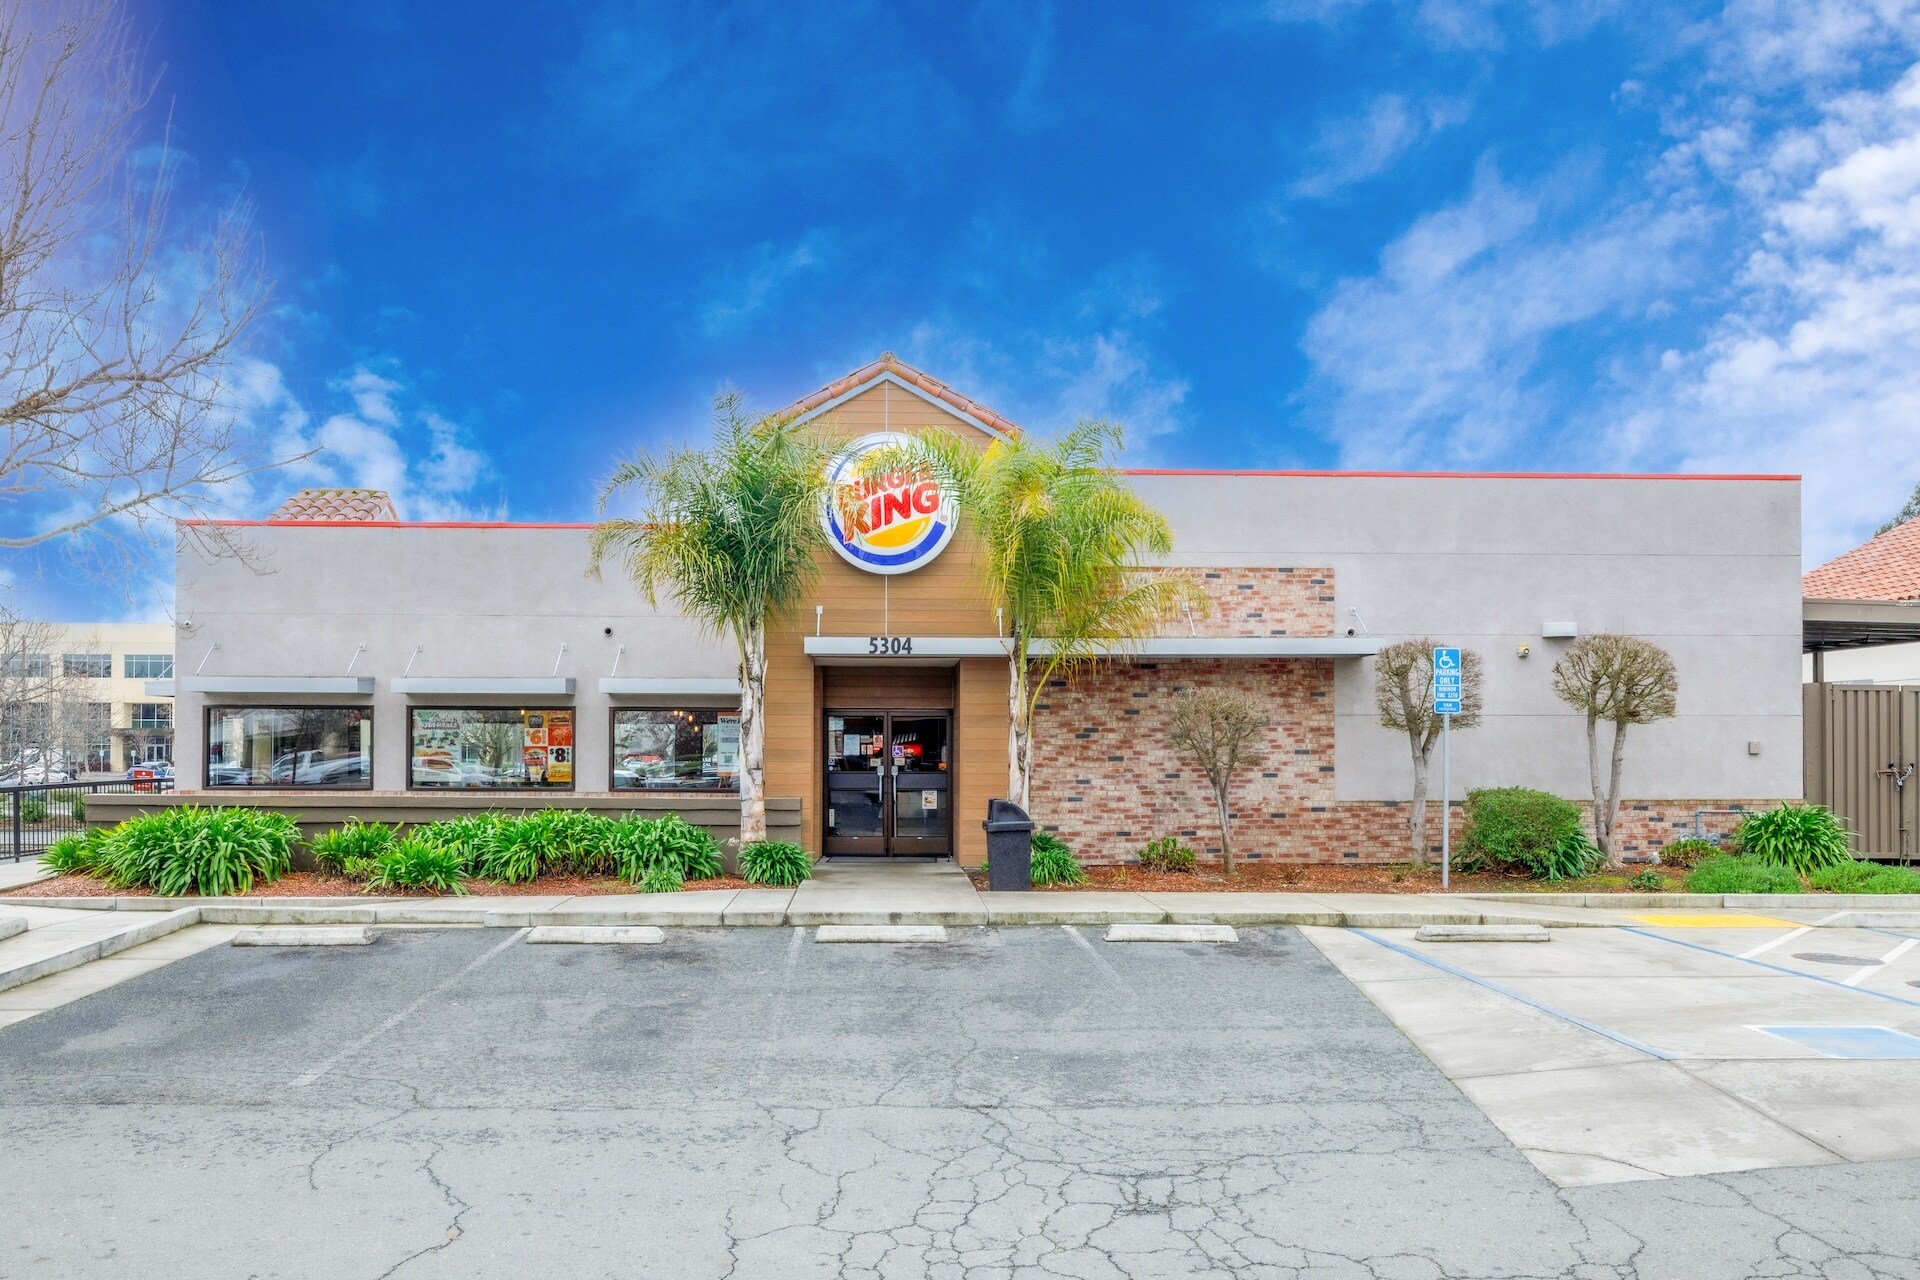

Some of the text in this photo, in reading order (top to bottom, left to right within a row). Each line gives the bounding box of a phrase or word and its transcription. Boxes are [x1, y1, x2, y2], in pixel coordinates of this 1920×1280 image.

[843, 482, 940, 542] KING
[869, 637, 912, 654] 5304
[1436, 668, 1459, 676] PARKING
[1440, 676, 1455, 684] ONLY
[526, 729, 542, 744] $6
[550, 748, 566, 763] $8
